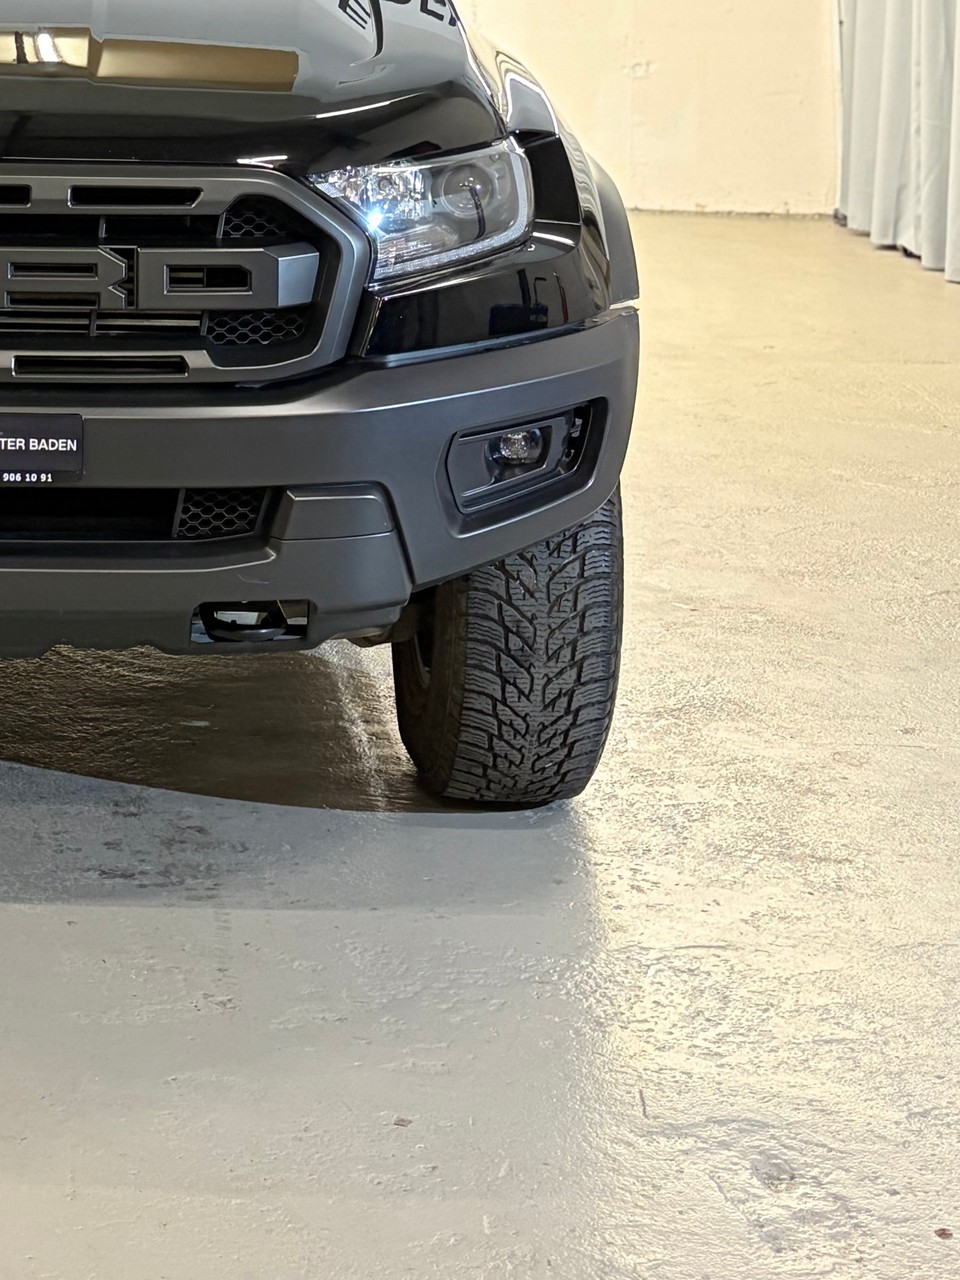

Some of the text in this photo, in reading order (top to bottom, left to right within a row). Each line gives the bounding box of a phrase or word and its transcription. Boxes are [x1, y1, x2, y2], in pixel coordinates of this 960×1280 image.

[29, 438, 78, 452] BADEN
[2, 472, 22, 482] 906
[25, 473, 38, 483] 10
[40, 473, 53, 483] 91
